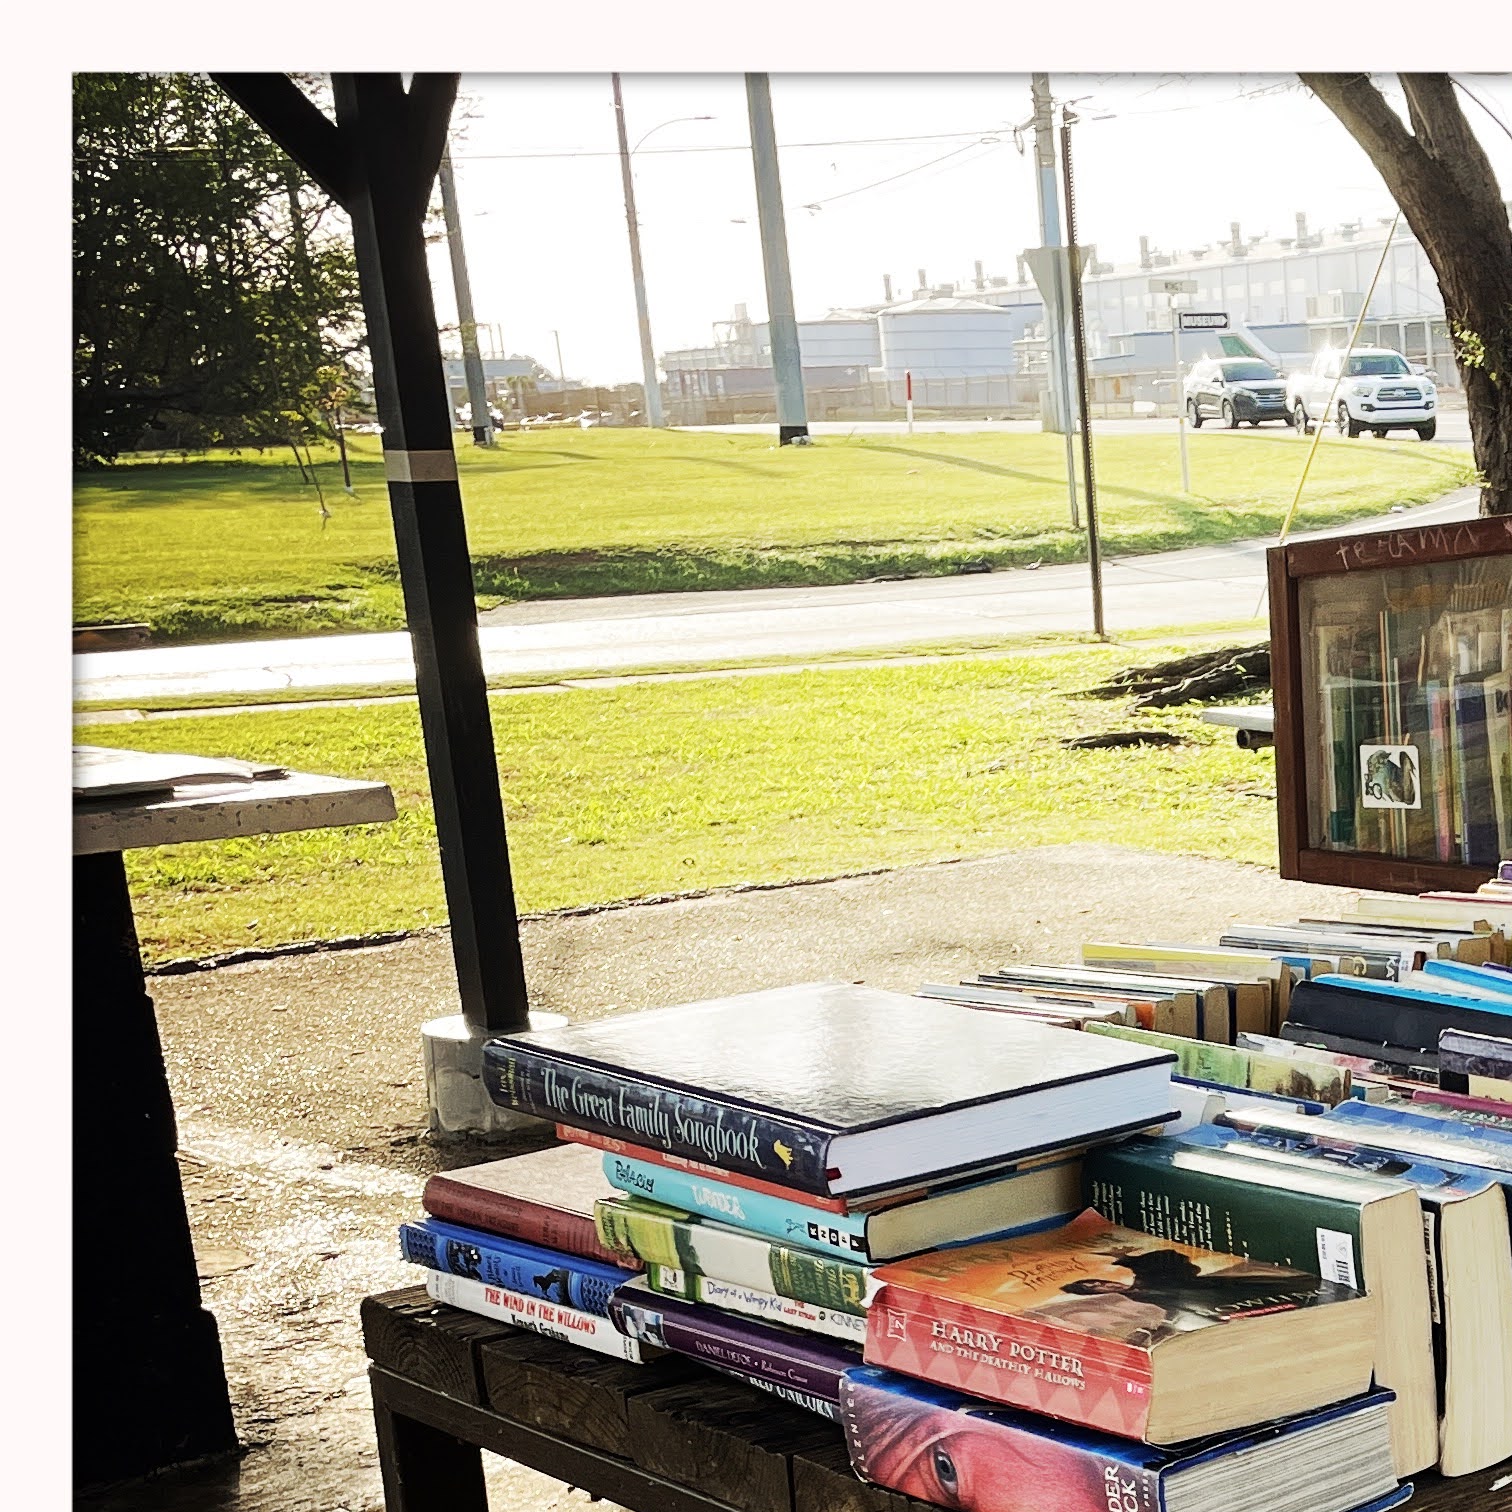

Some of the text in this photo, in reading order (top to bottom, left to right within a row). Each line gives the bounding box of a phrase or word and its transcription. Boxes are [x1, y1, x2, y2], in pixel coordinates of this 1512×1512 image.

[541, 1065, 569, 1112] The
[571, 1075, 616, 1128] Great
[618, 1086, 672, 1149] Family
[673, 1102, 768, 1170] Songbook
[484, 1287, 597, 1335] THE WIND IN THE WILLOWS
[707, 1281, 730, 1301] Diary
[744, 1292, 769, 1311] Wimpy
[769, 1295, 784, 1312] Kid
[695, 1340, 725, 1360] DANIEL
[930, 1340, 1087, 1391] AND THE DEATHLY HALLOWS
[931, 1319, 1085, 1377] HARRY POTTER
[775, 1385, 835, 1418] UNICORN
